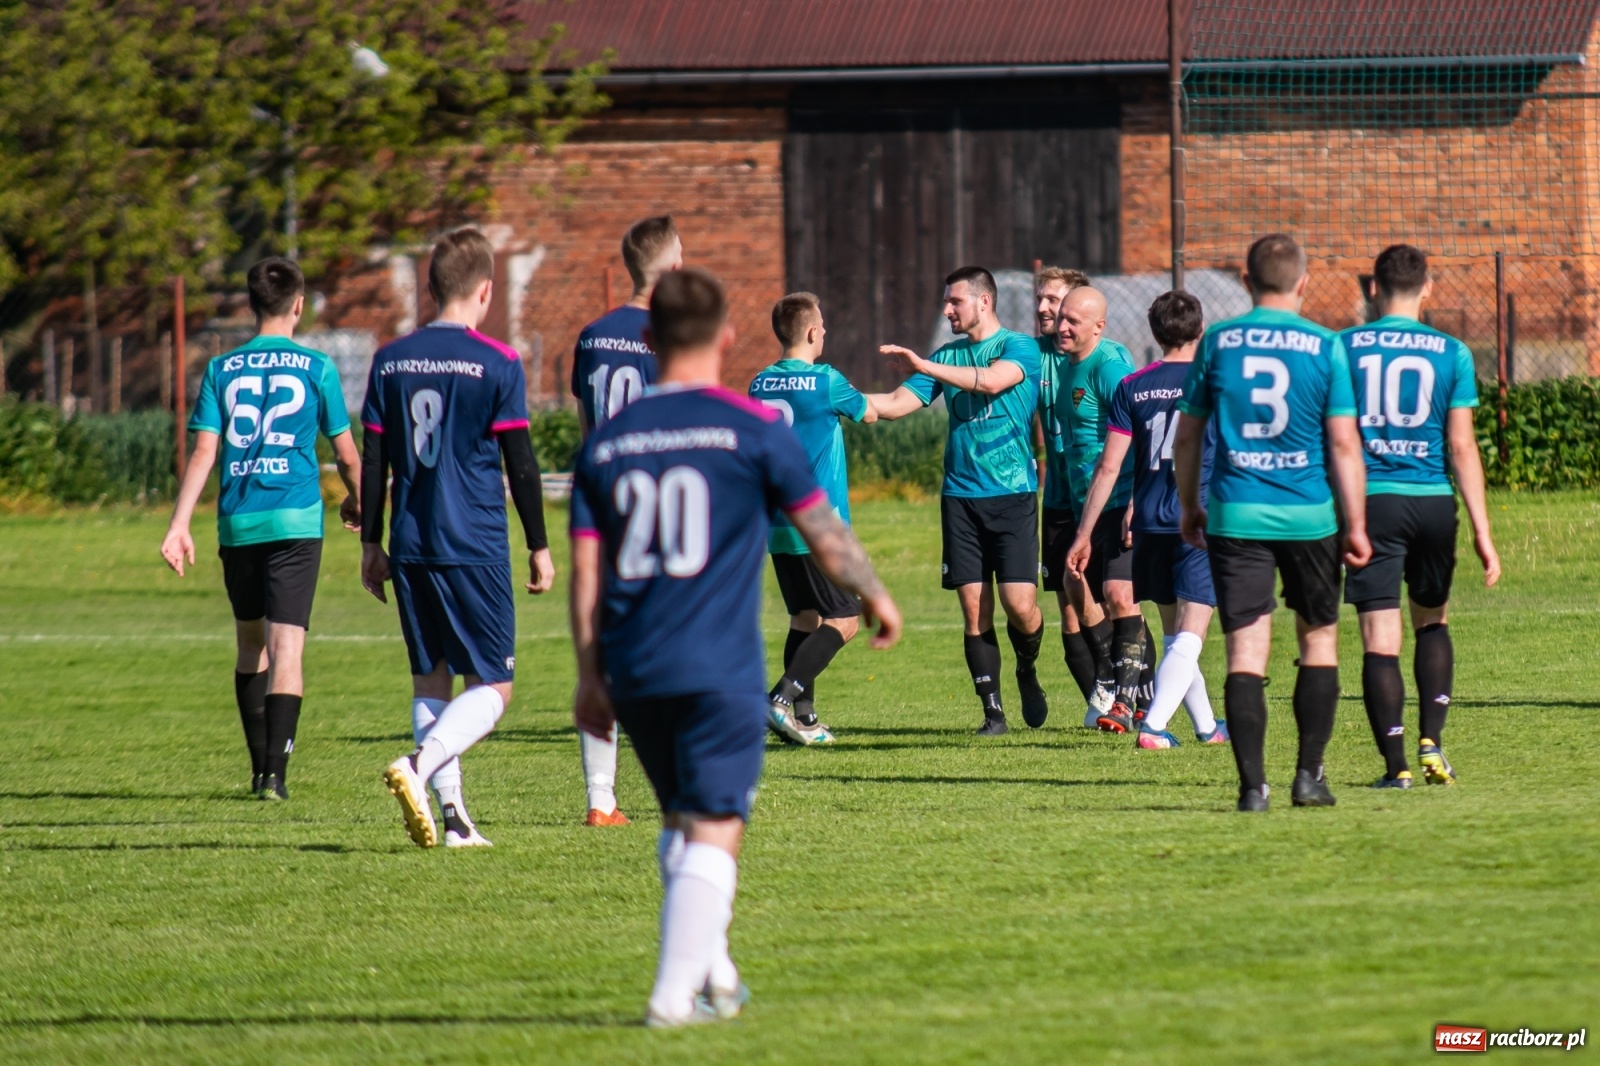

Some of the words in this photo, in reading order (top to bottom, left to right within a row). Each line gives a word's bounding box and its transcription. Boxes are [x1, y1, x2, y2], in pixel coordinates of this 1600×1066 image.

[223, 354, 244, 372] KS
[247, 352, 311, 371] CZARNI
[1218, 328, 1244, 349] KS
[1246, 328, 1321, 356] CZARNI
[1352, 331, 1377, 348] KS
[1379, 331, 1446, 354] CZARNI
[396, 358, 484, 378] KRZYŻANOWICE
[762, 376, 816, 392] CZARNI
[1358, 354, 1435, 428] 10
[225, 374, 306, 448] 62
[1242, 355, 1290, 439] 3
[411, 388, 443, 468] 8
[614, 465, 710, 580] 20
